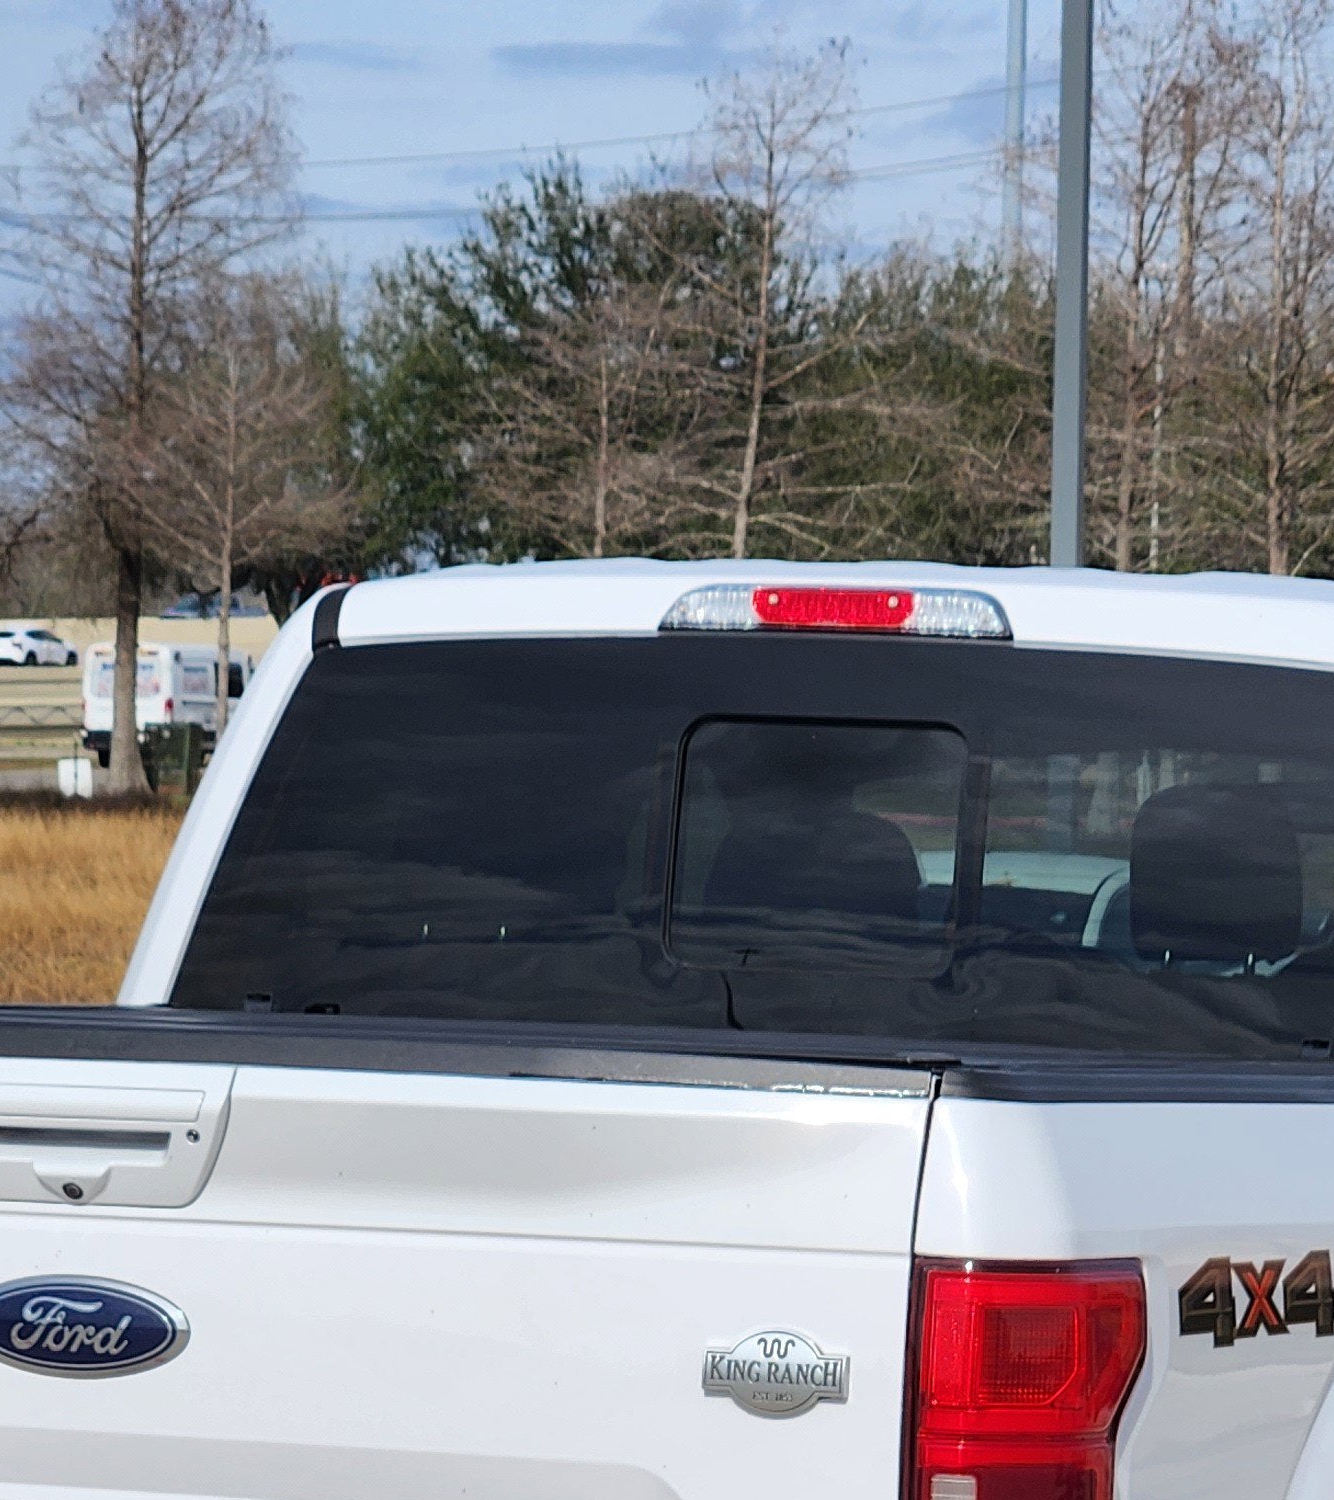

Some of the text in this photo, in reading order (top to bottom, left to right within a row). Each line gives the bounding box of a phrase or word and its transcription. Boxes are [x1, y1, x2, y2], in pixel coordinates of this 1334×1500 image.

[10, 1295, 133, 1356] Ford
[710, 1354, 839, 1387] KING RANCH
